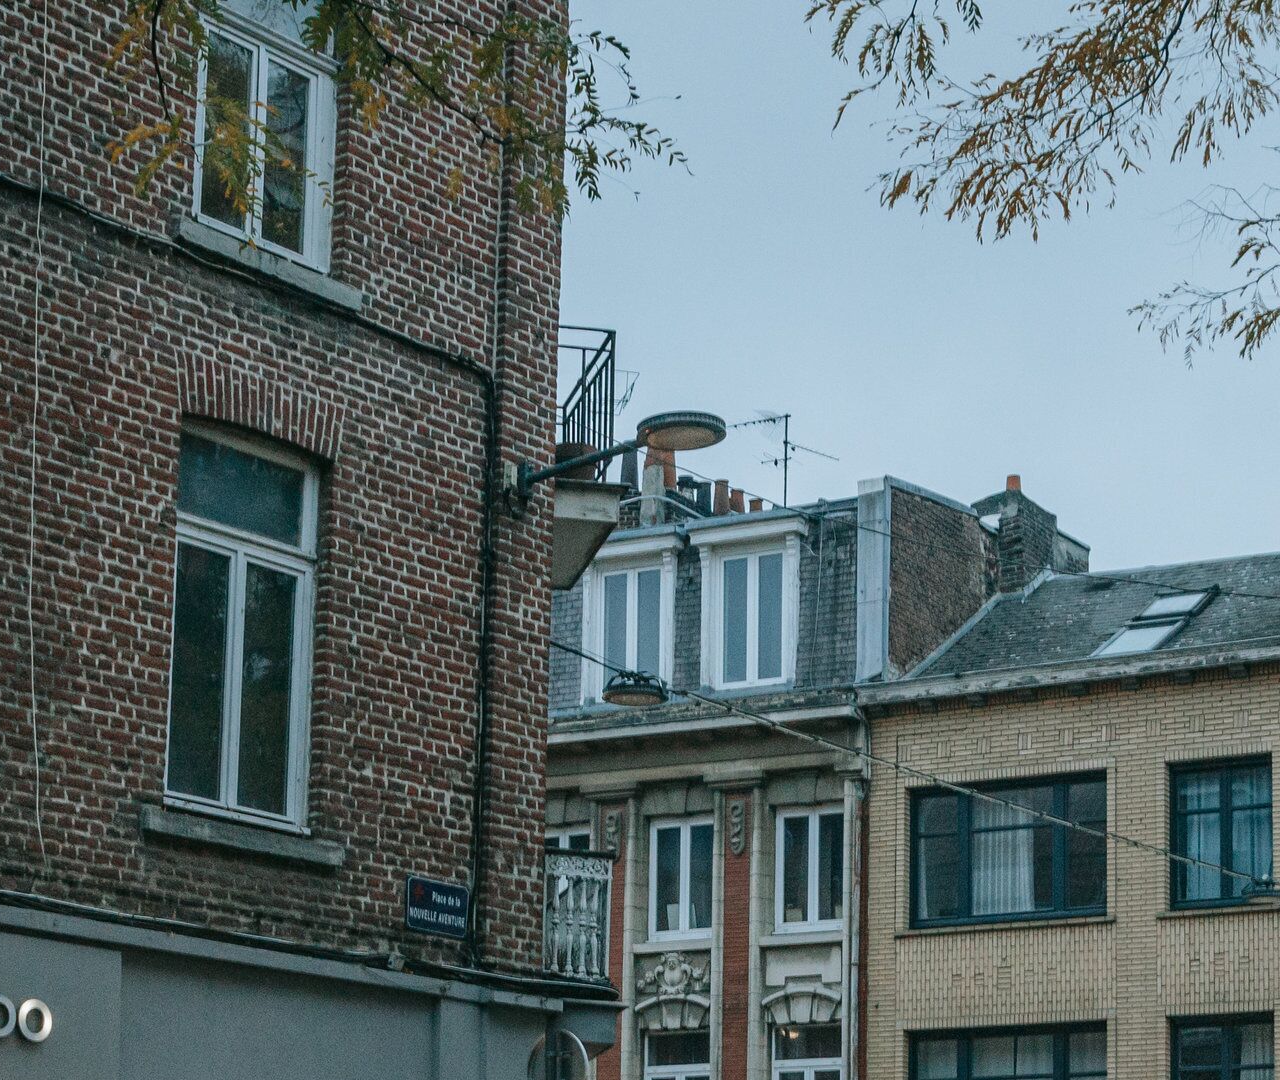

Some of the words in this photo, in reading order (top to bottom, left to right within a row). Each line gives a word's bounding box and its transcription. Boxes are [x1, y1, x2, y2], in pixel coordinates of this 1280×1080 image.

[432, 891, 447, 904] Place
[448, 896, 455, 906] de
[455, 897, 461, 907] la
[409, 907, 437, 921] NOUVELLE
[438, 913, 465, 928] AVENTURE
